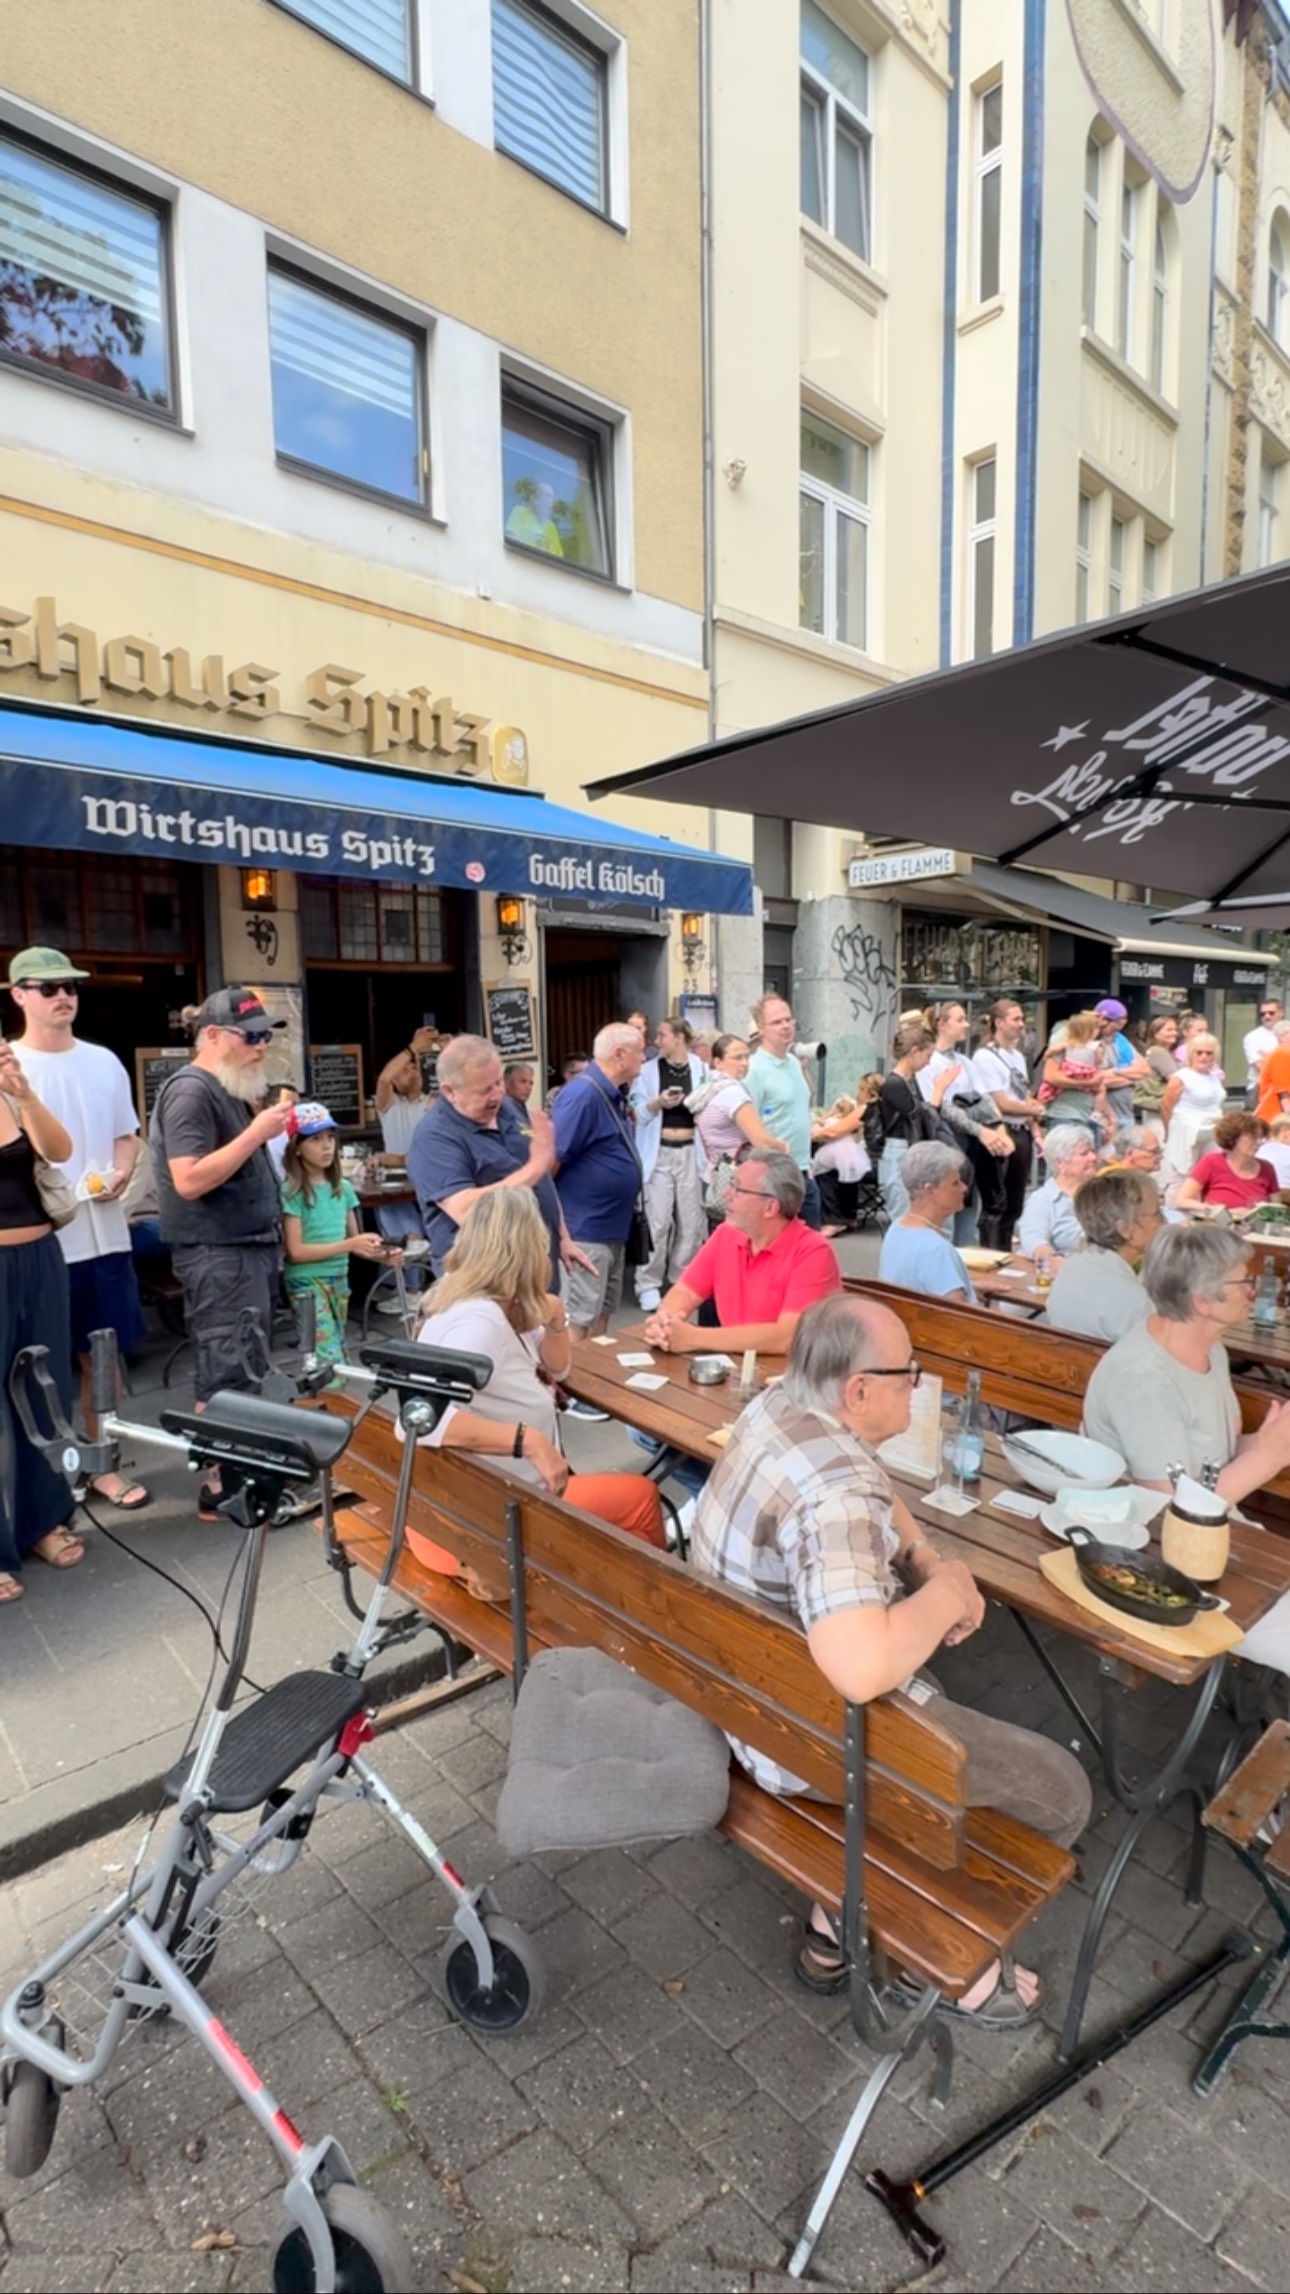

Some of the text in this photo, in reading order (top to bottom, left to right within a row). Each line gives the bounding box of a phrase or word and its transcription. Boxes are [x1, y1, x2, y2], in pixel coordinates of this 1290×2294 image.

[303, 663, 492, 776] Spitz
[81, 795, 436, 876] Wirtshaus Spitz
[852, 862, 888, 883] FEUER
[900, 852, 952, 877] FLAMME
[528, 853, 665, 902] Gaffel Kölsch
